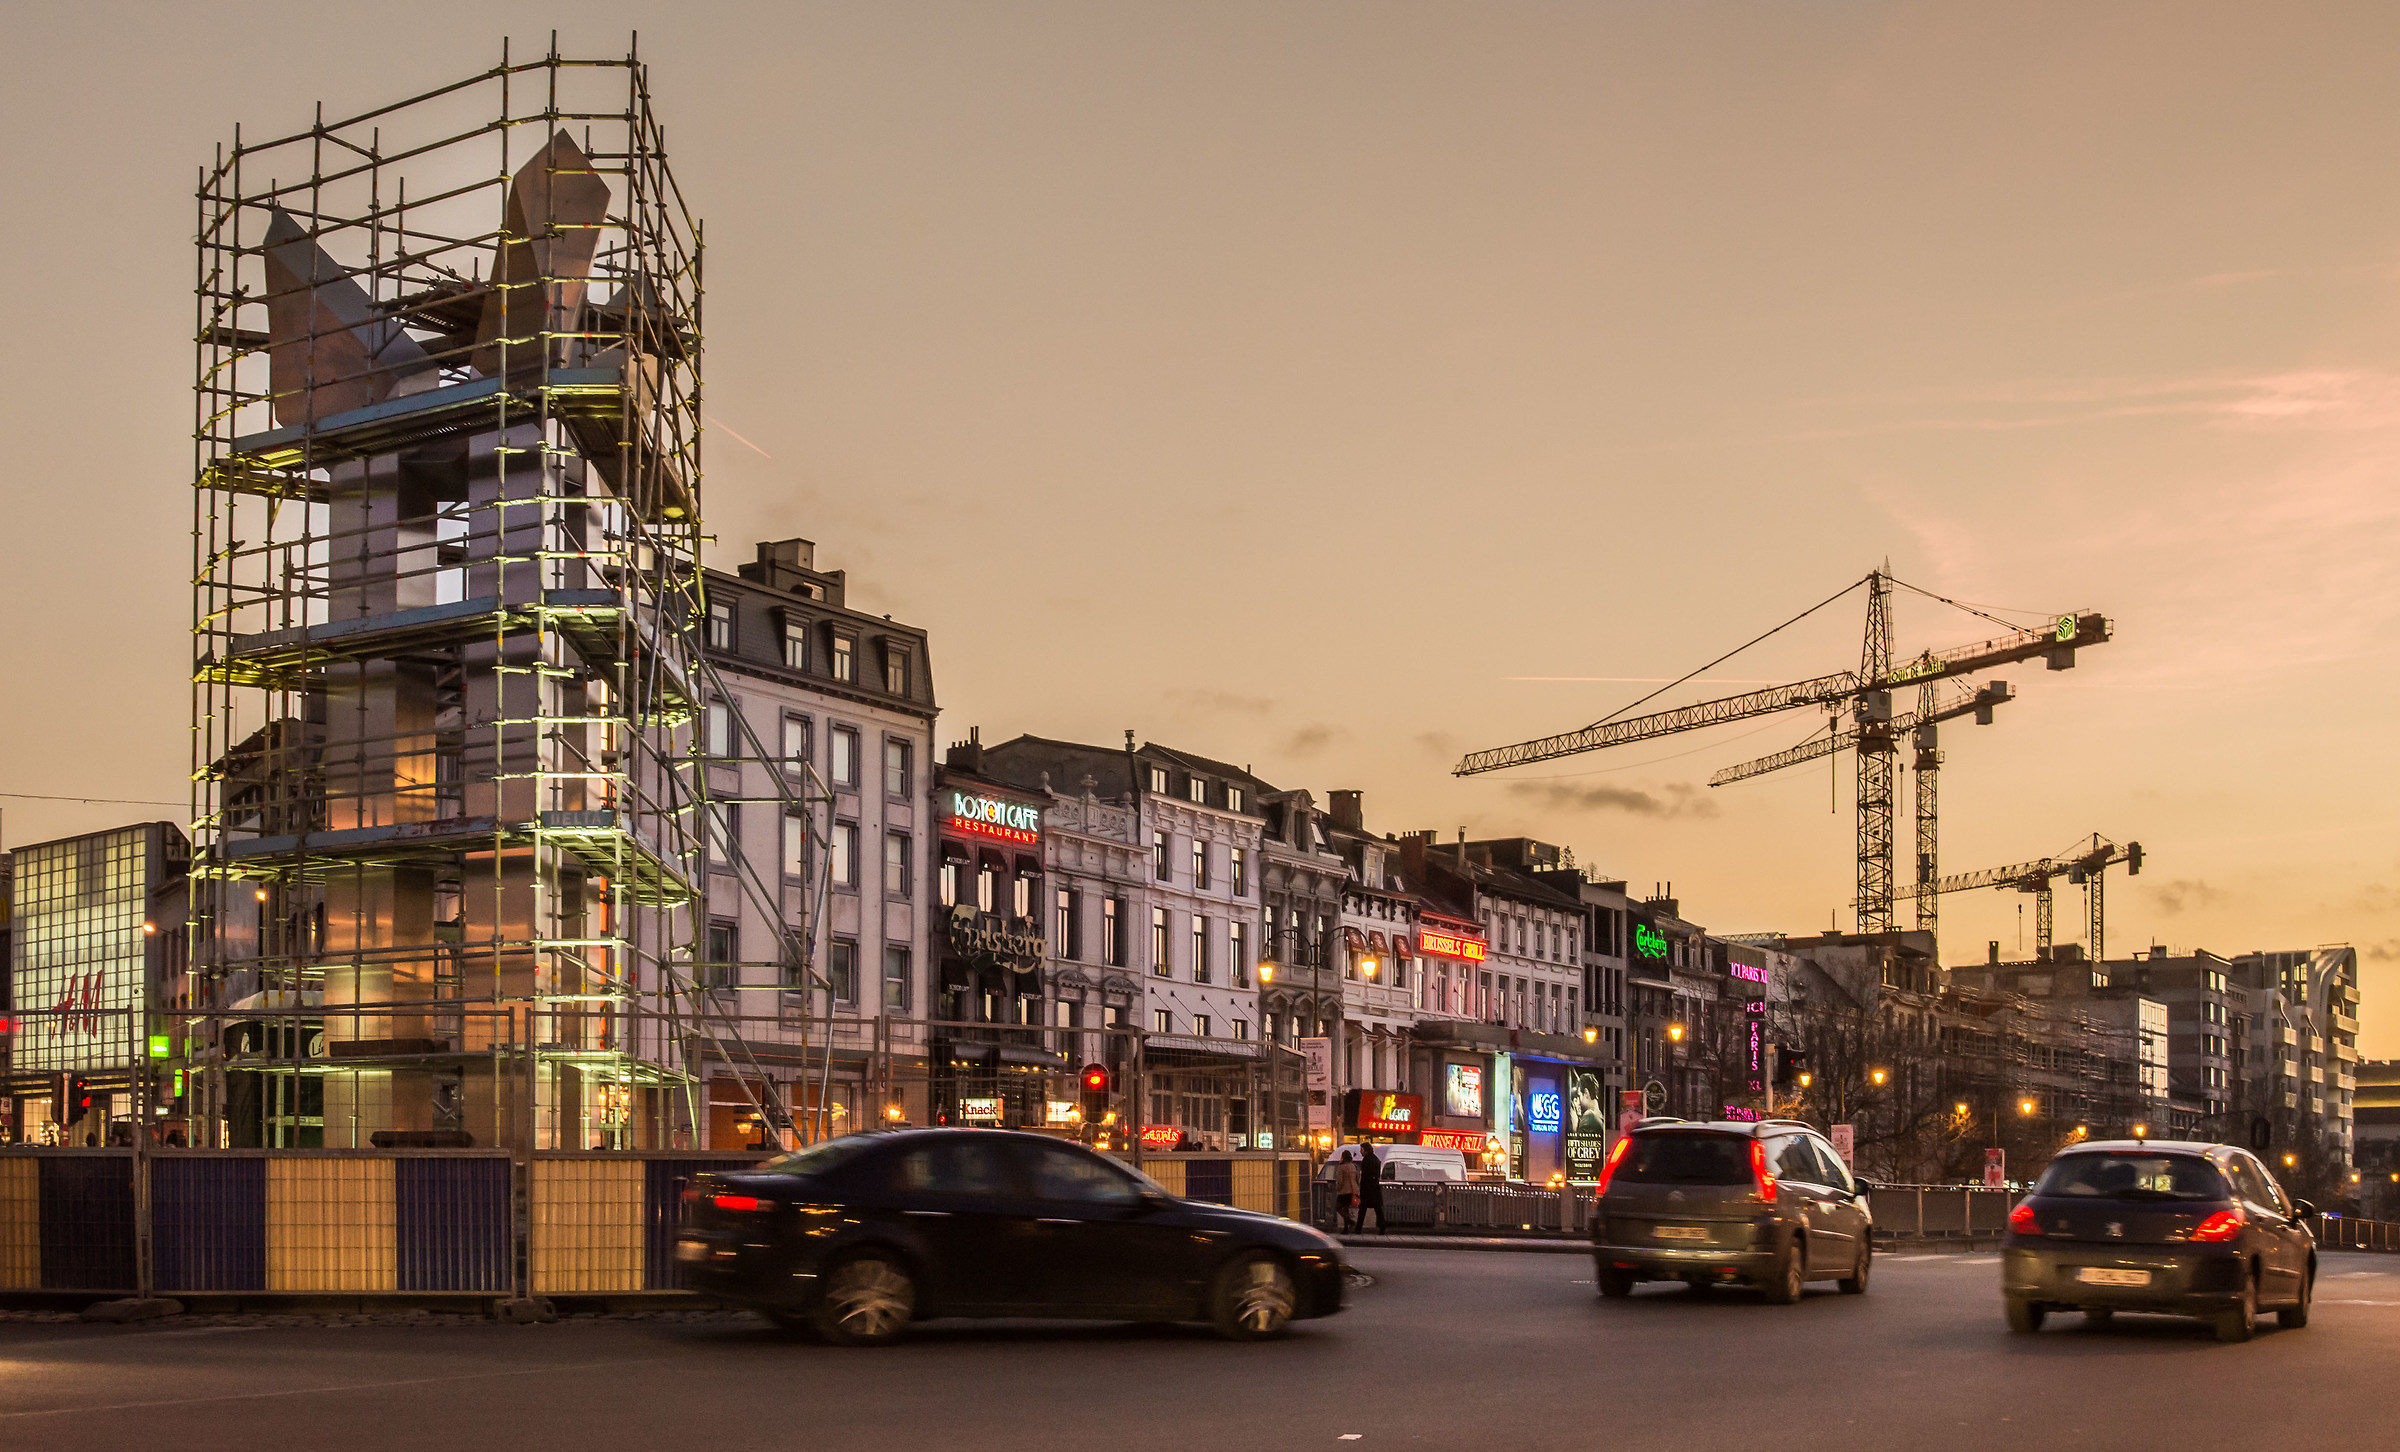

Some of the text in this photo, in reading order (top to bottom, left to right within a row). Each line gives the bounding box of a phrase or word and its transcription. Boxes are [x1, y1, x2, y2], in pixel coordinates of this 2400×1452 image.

[1888, 661, 1943, 684] LOUIS DE WAELE
[550, 812, 602, 826] DELTA
[954, 793, 1039, 832] BOSTON CAFE
[955, 818, 1038, 843] RESTAURANT
[1423, 934, 1485, 960] BRUSSELS GRILL
[1636, 924, 1667, 957] Carlsberg
[1741, 964, 1759, 982] PARIS
[51, 970, 103, 1040] H&M
[1746, 1001, 1763, 1013] ICI
[1750, 1022, 1759, 1071] PARIS
[1748, 1080, 1762, 1091] XL
[965, 1103, 997, 1115] Knack
[1422, 1134, 1483, 1151] BRUSSELS GRILL
[1580, 1140, 1602, 1148] SHADES
[1567, 1147, 1601, 1159] OF GREY
